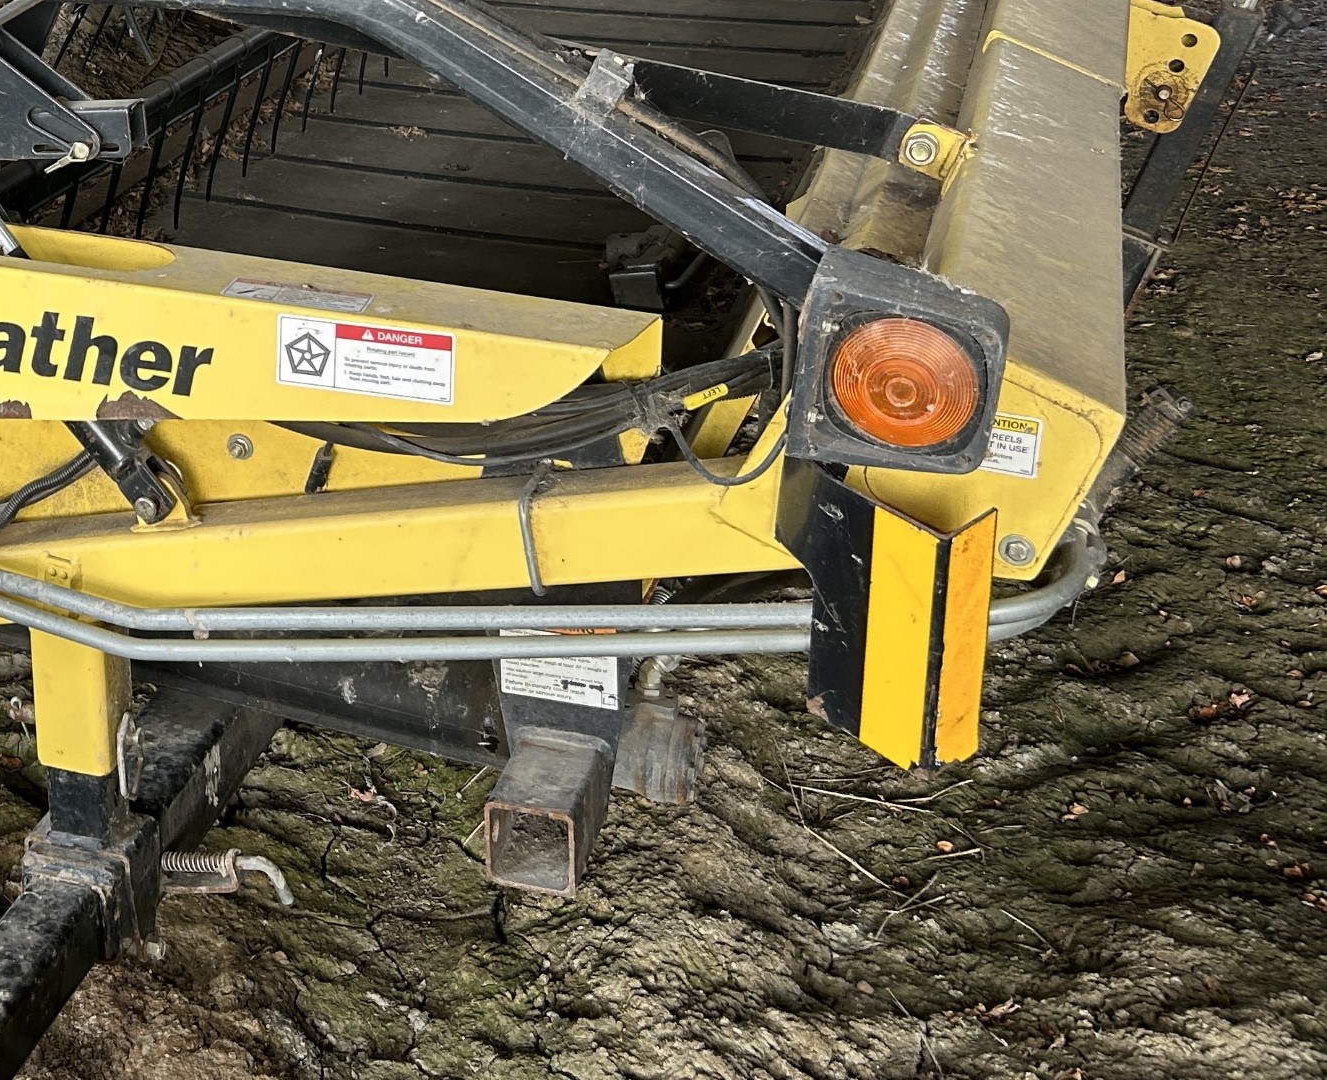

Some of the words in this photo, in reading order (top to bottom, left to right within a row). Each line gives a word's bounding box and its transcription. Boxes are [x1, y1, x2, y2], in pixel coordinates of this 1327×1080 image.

[377, 332, 422, 345] DANGER
[703, 386, 721, 400] LEFT
[994, 419, 1028, 430] NTION
[992, 433, 1022, 444] REELS
[997, 442, 1006, 450] IN
[1009, 444, 1028, 453] USE
